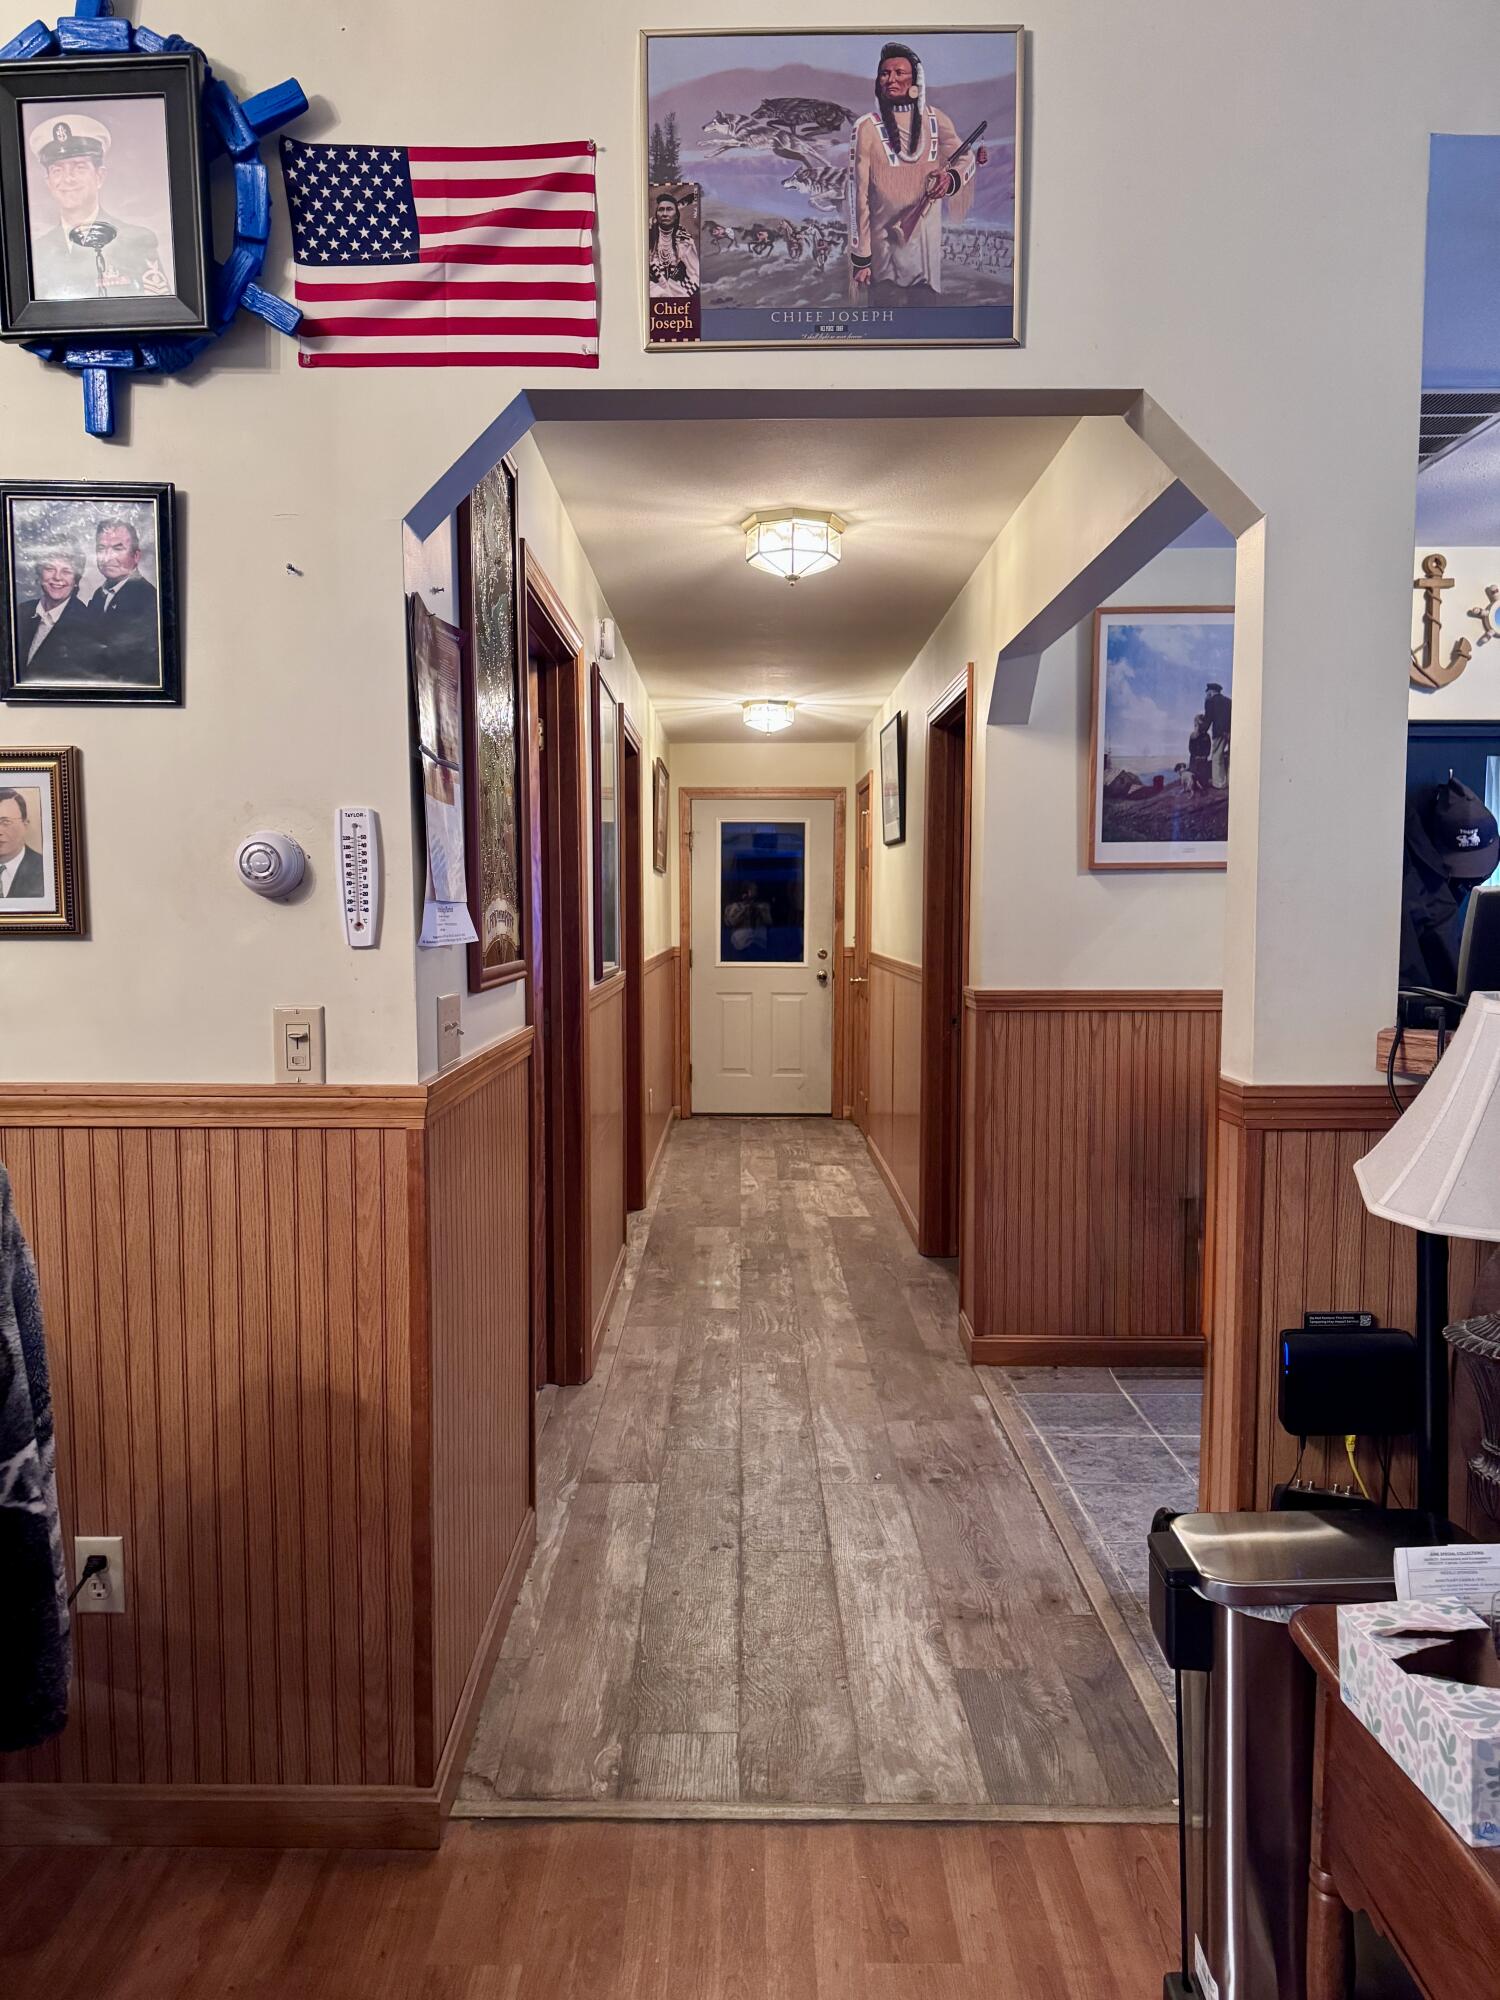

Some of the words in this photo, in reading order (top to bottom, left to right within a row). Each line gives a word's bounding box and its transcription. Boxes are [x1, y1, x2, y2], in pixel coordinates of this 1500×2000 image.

[654, 301, 691, 315] Chief
[650, 315, 694, 333] Joseph
[771, 311, 823, 323] CHIEF
[828, 311, 894, 322] JOSEPH
